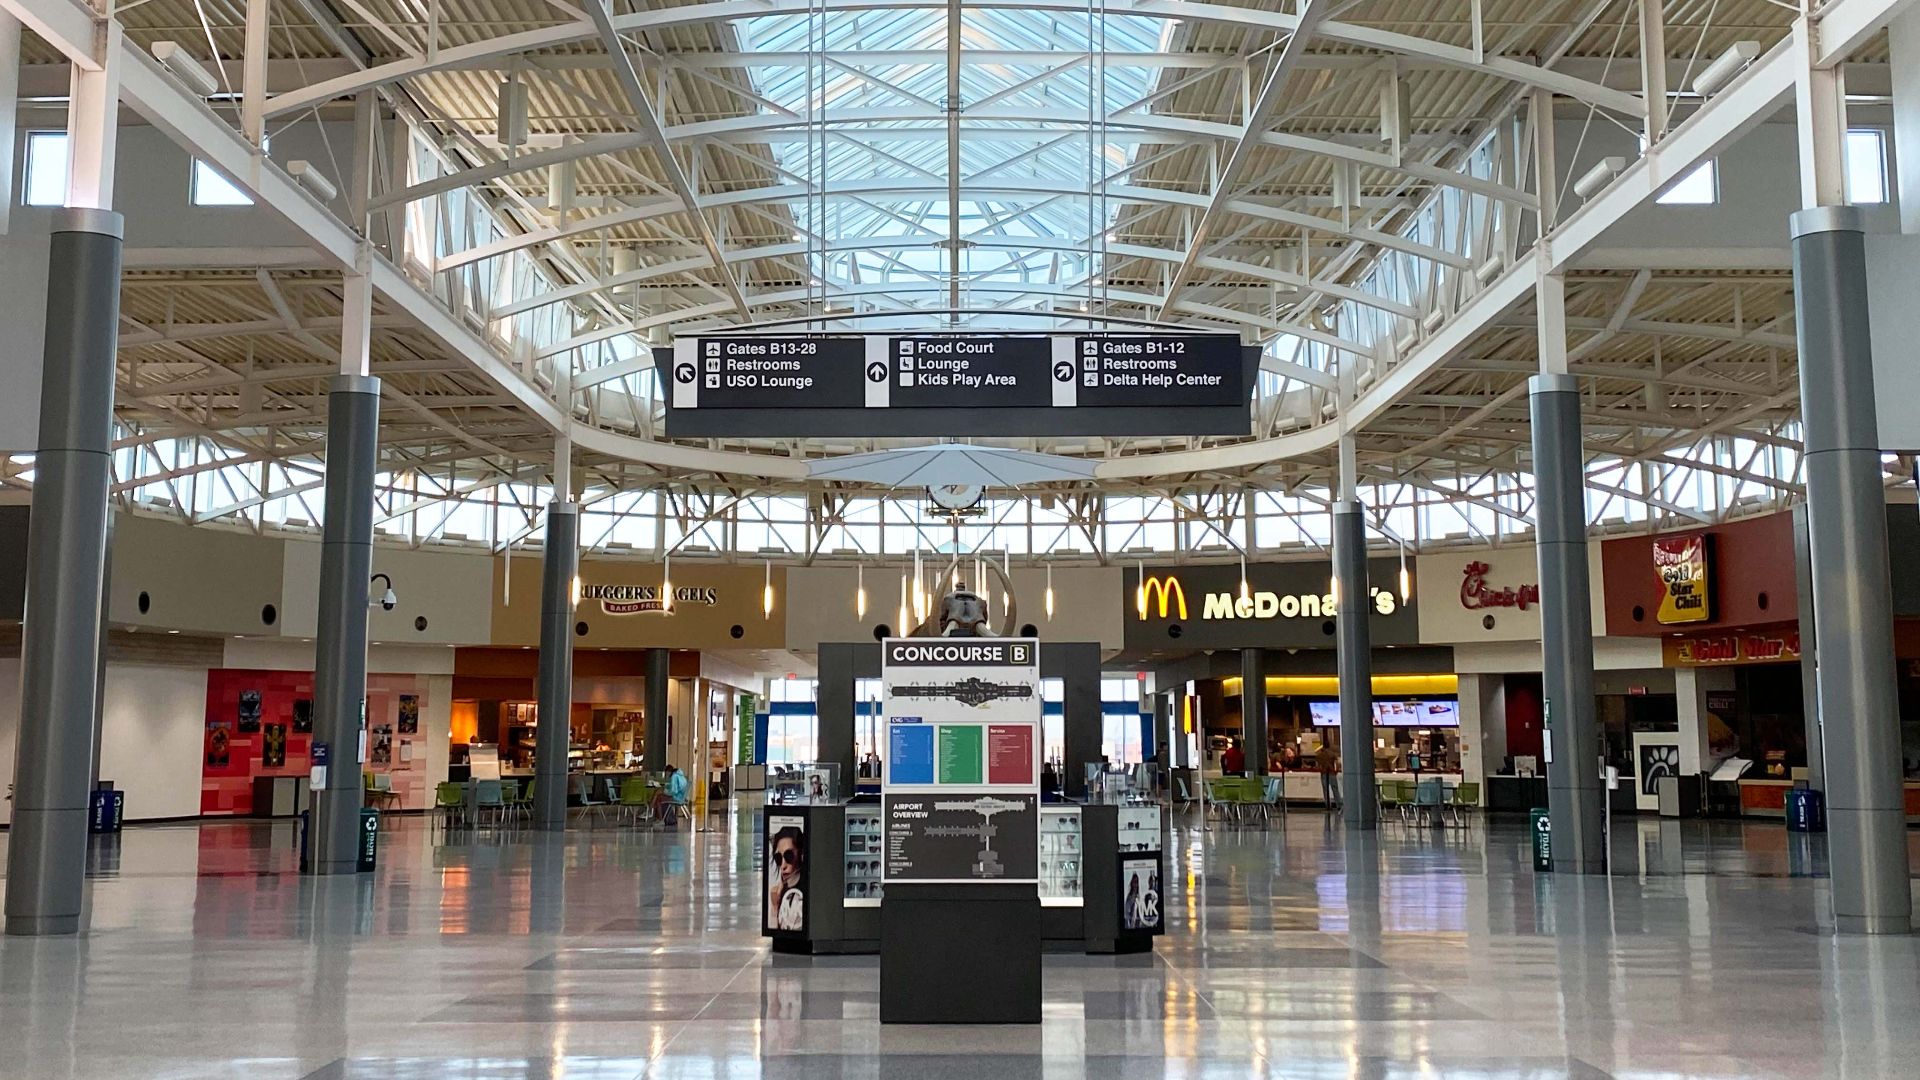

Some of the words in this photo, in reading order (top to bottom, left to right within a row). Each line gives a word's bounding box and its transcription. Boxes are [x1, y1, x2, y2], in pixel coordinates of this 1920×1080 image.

[726, 343, 766, 355] Gates
[770, 343, 817, 355] B13-28
[918, 342, 952, 354] Food
[956, 342, 994, 354] Court
[1103, 342, 1142, 354] Gates
[1146, 342, 1185, 354] B1-12
[726, 359, 801, 371] Restrooms
[918, 358, 970, 372] Lounge
[1103, 358, 1177, 370] Restrooms
[726, 375, 757, 387] USO
[761, 375, 813, 389] Lounge
[918, 374, 949, 386] Kids
[952, 374, 981, 388] Play
[984, 374, 1017, 386] Area
[1103, 374, 1139, 386] Delta
[1142, 374, 1173, 388] Help
[1176, 374, 1222, 386] Center
[1670, 582, 1695, 597] Star
[609, 603, 638, 612] BAKED
[641, 600, 664, 610] FRES
[1203, 587, 1395, 620] McDona's
[1675, 594, 1702, 610] Chili
[892, 646, 1003, 661] CONCOURSE
[1014, 647, 1025, 660] B
[1693, 637, 1738, 662] Gold
[892, 811, 929, 819] OVERVIEW
